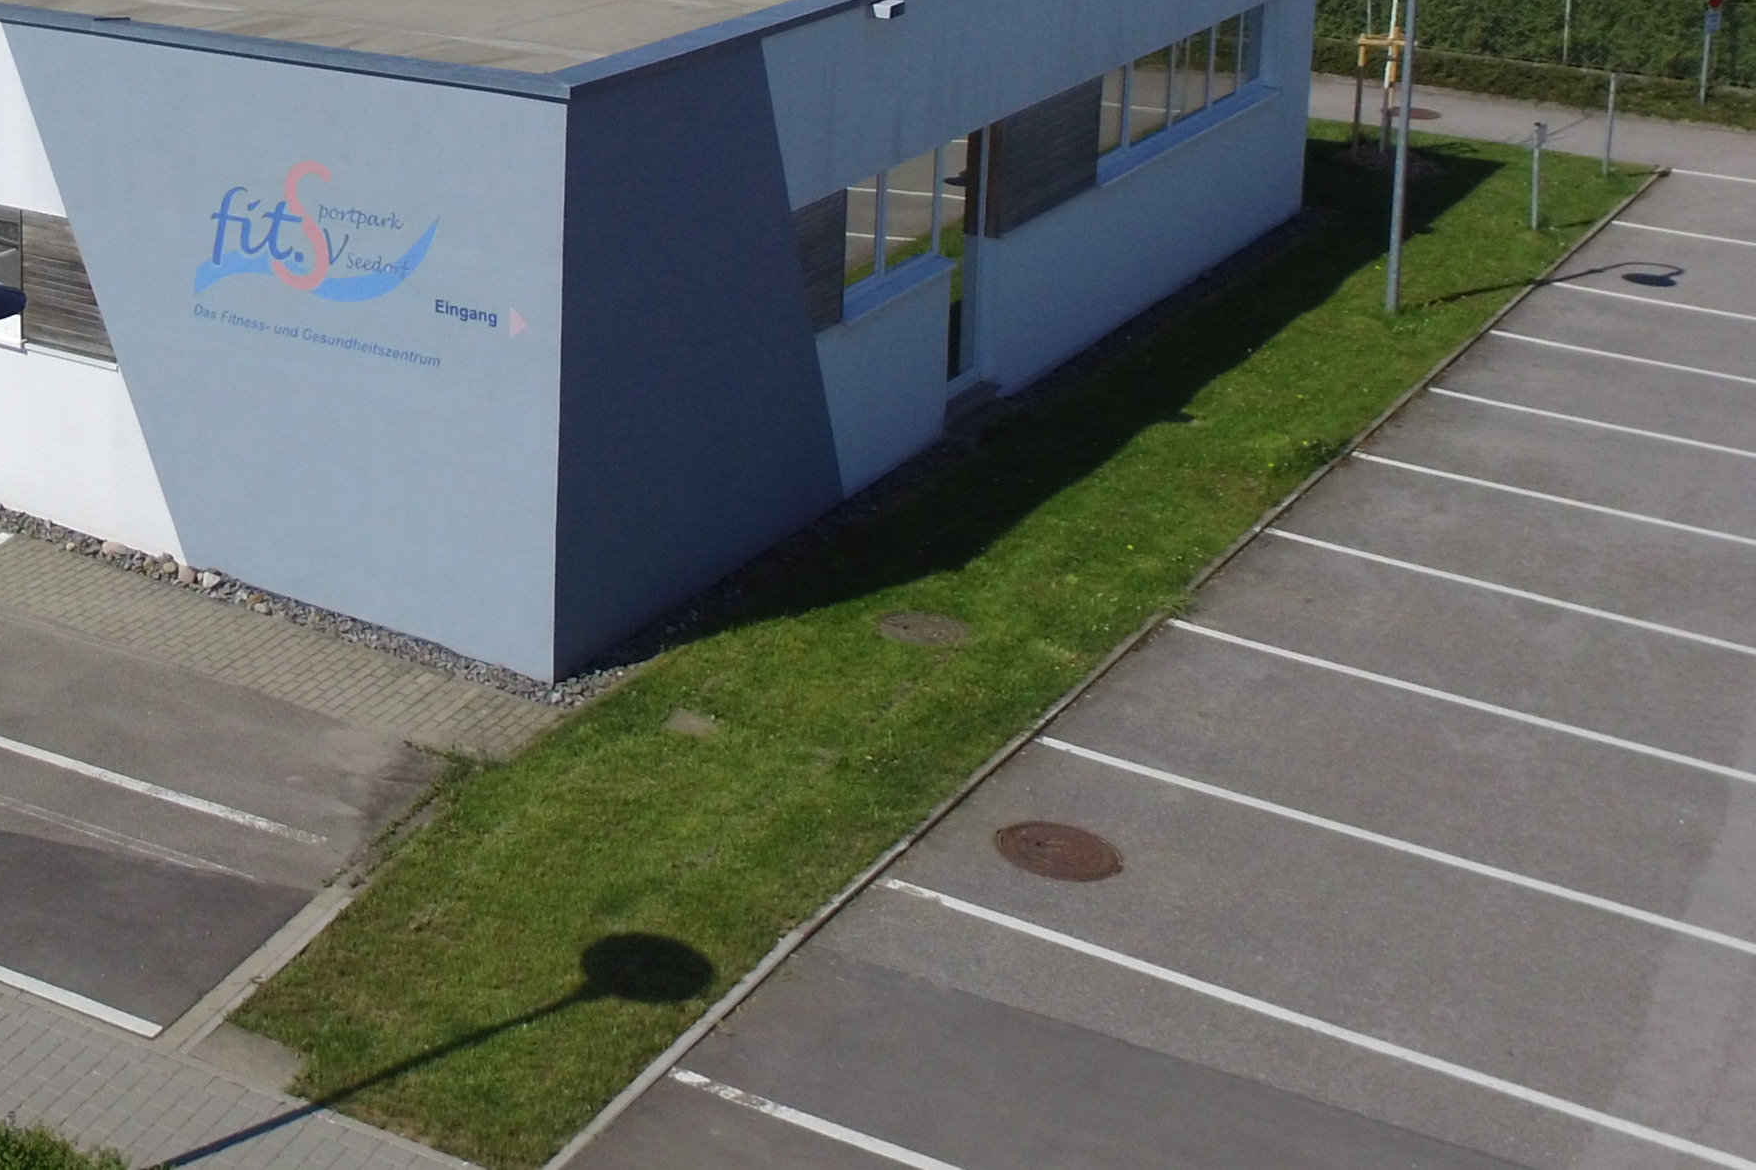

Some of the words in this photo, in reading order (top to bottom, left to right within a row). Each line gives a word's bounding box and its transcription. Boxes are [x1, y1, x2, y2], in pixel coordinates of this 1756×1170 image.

[347, 253, 411, 281] Seedorf
[435, 299, 498, 327] Eingang
[194, 303, 217, 320] Das
[220, 310, 270, 331] Fitness-
[273, 324, 299, 338] und
[302, 328, 441, 367] Gesundheitszentrum
